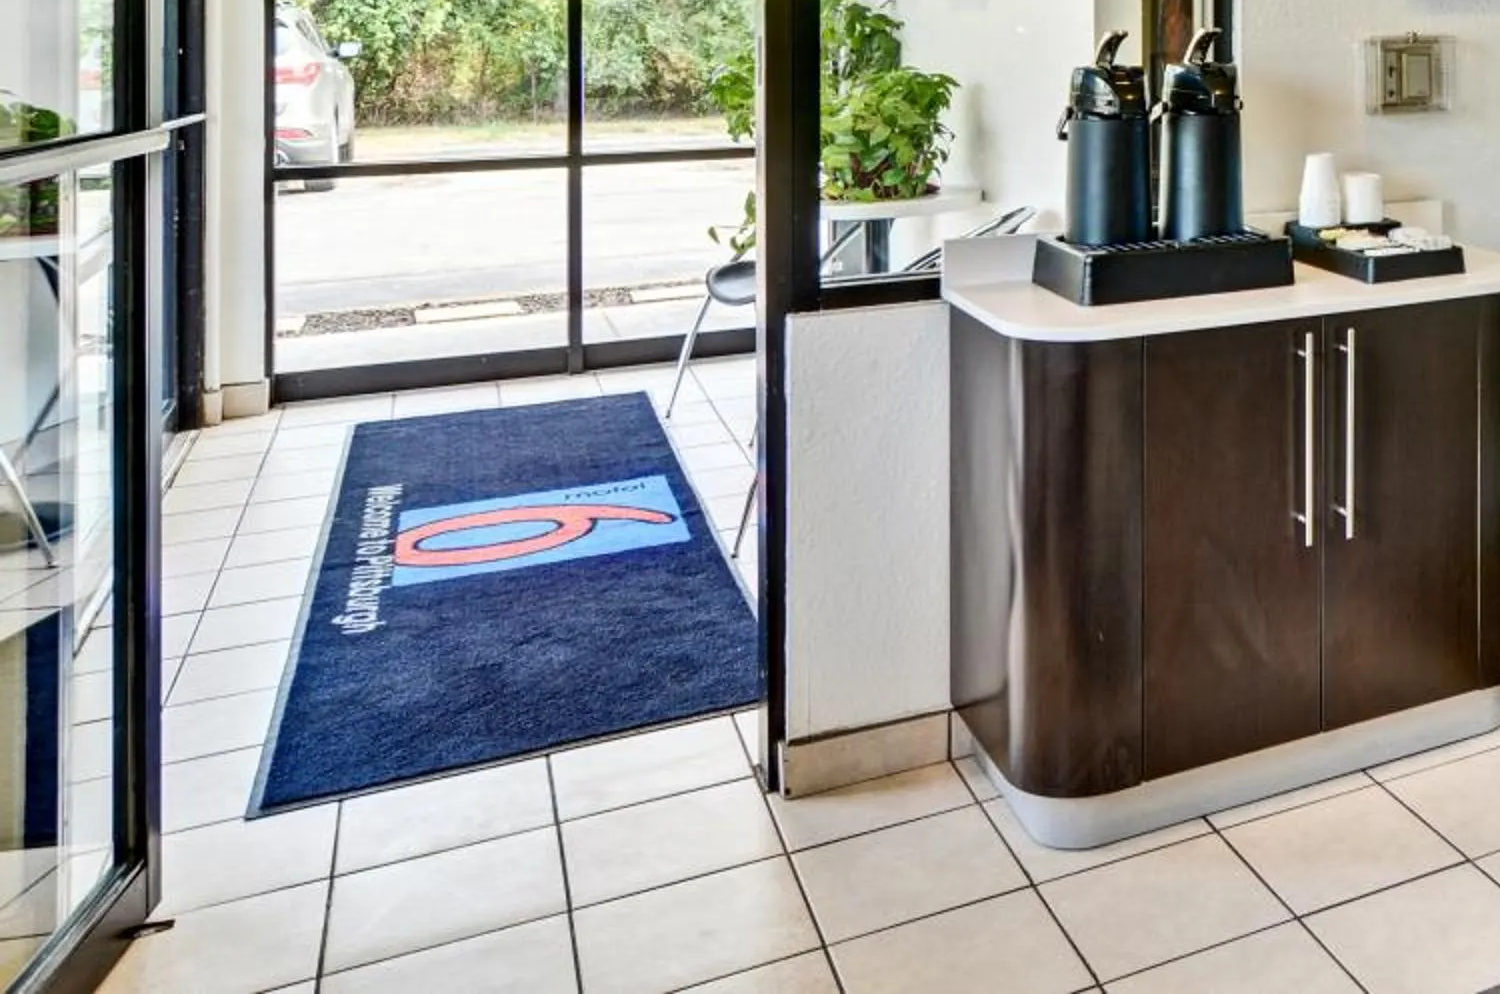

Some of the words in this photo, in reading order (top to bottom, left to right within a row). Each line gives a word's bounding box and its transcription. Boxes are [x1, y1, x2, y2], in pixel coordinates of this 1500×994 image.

[358, 483, 404, 539] Welcome
[564, 482, 646, 501] motel
[356, 538, 397, 555] to
[393, 504, 676, 567] 6
[330, 554, 394, 635] Pittsburgh
